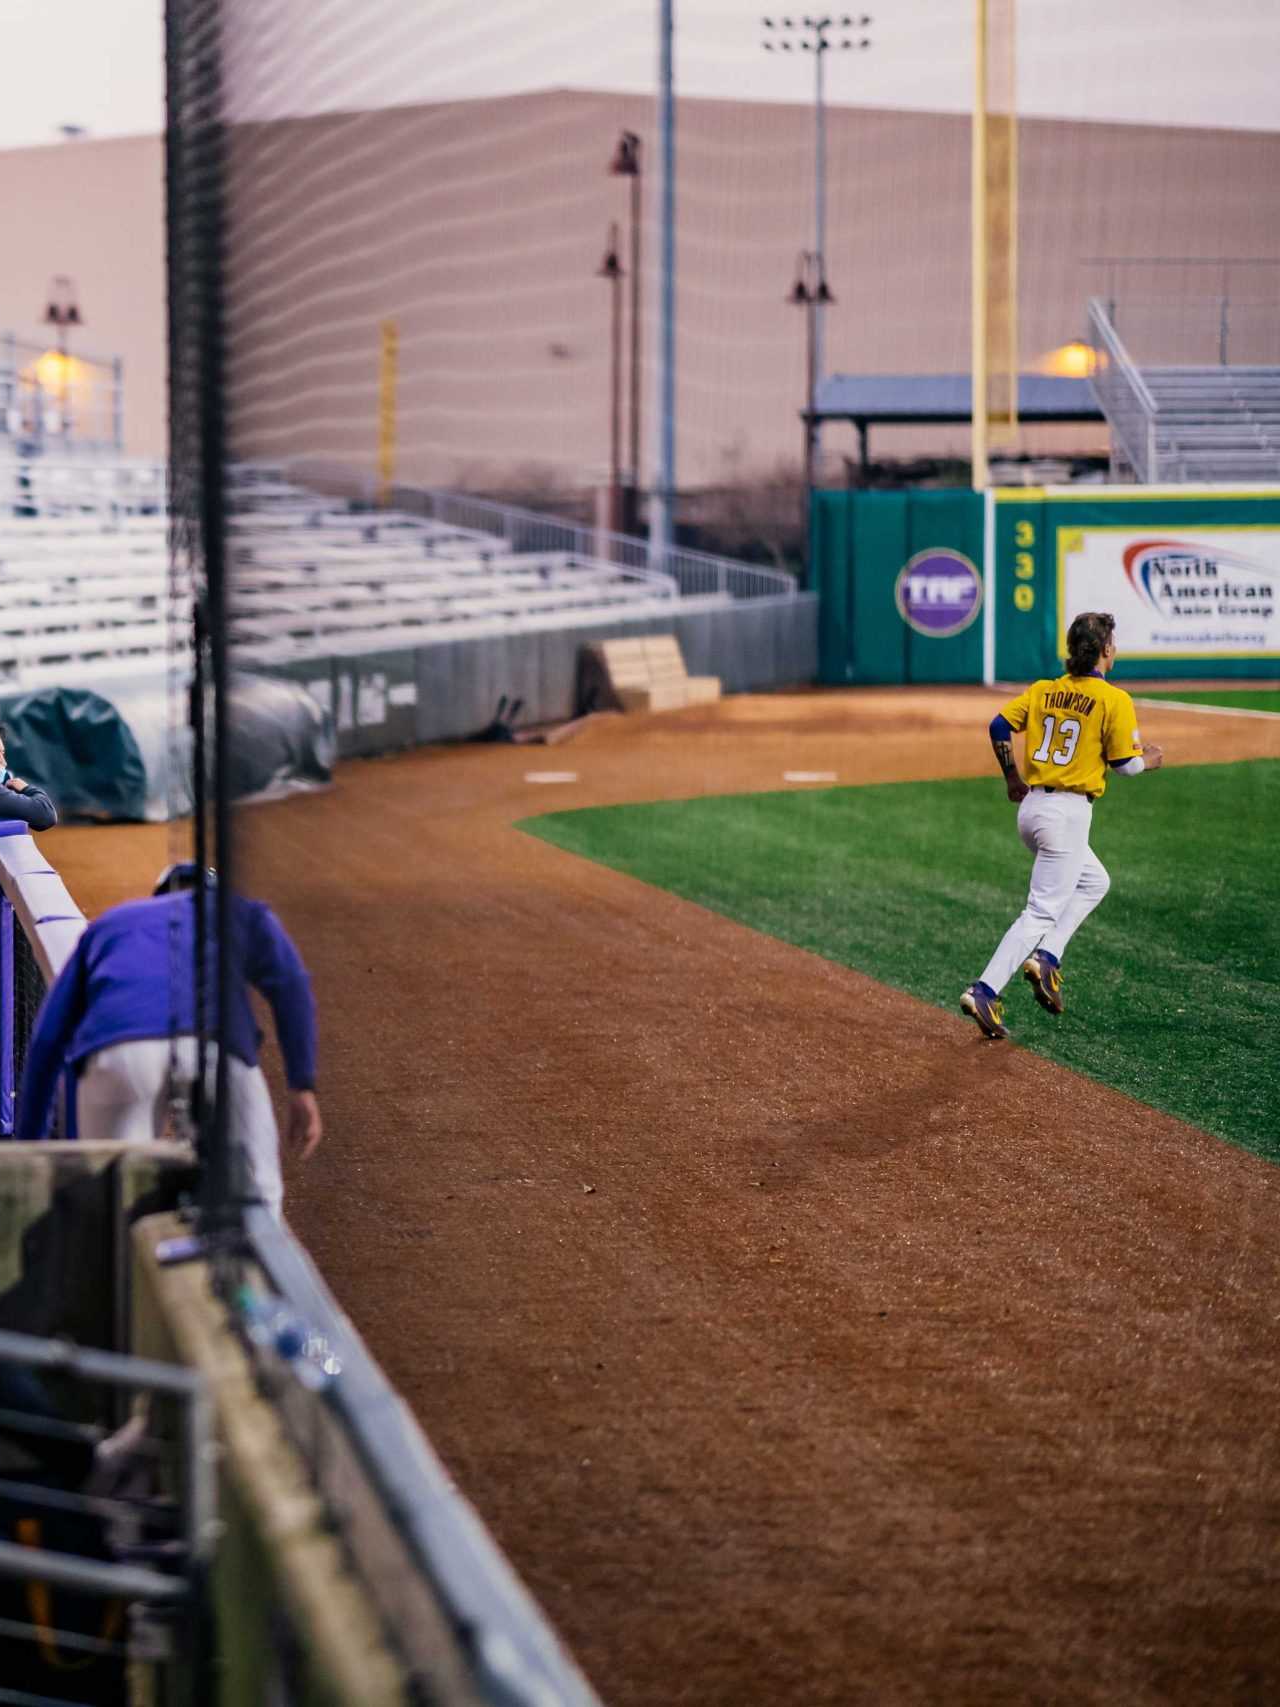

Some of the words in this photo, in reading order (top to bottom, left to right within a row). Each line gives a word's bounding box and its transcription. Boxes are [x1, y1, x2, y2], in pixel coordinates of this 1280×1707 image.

[1151, 558, 1218, 577] North
[1160, 583, 1273, 597] American
[1173, 605, 1213, 615] Auto
[1218, 605, 1273, 618] Group
[1044, 691, 1097, 717] THOMPSON
[1033, 714, 1081, 768] 13
